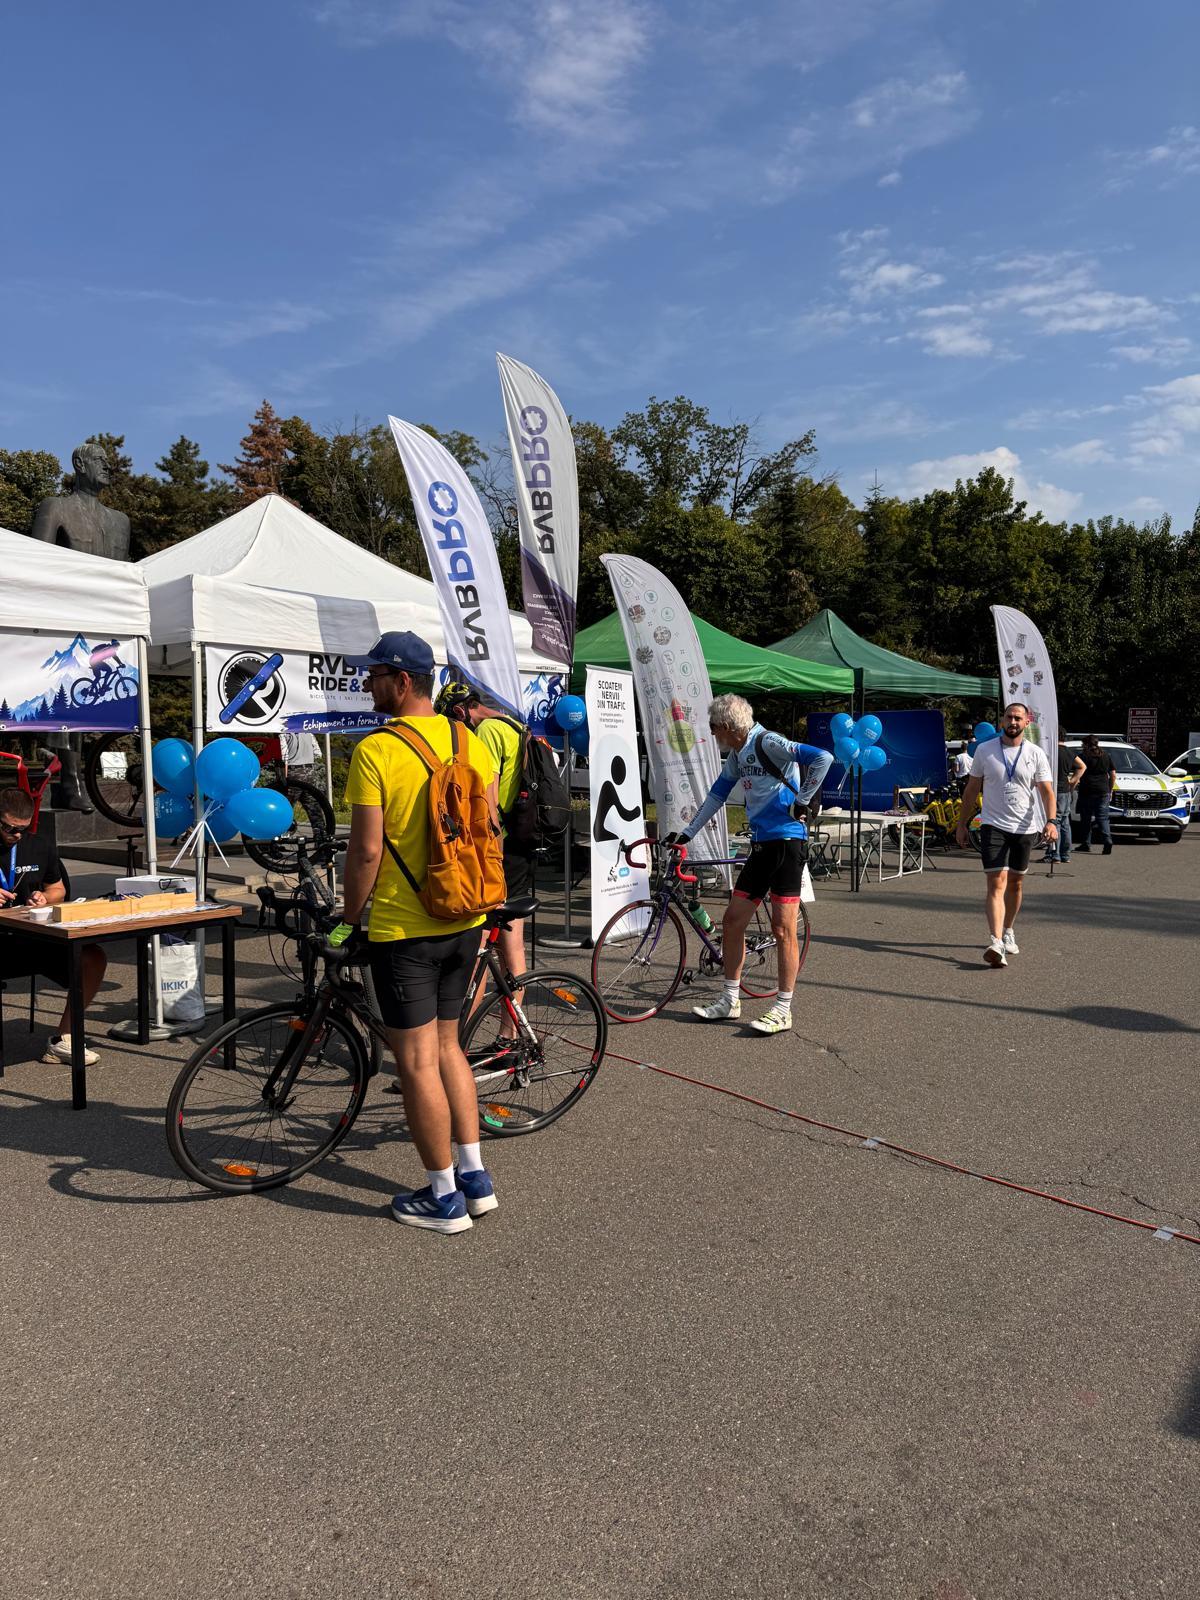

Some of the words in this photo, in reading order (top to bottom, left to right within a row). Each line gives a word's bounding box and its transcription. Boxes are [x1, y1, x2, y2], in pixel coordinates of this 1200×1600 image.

[598, 680, 622, 691] SCOATEM
[601, 690, 620, 700] NERVII
[607, 701, 627, 710] TRAFIC
[303, 718, 346, 730] Echipament
[347, 718, 355, 726] în
